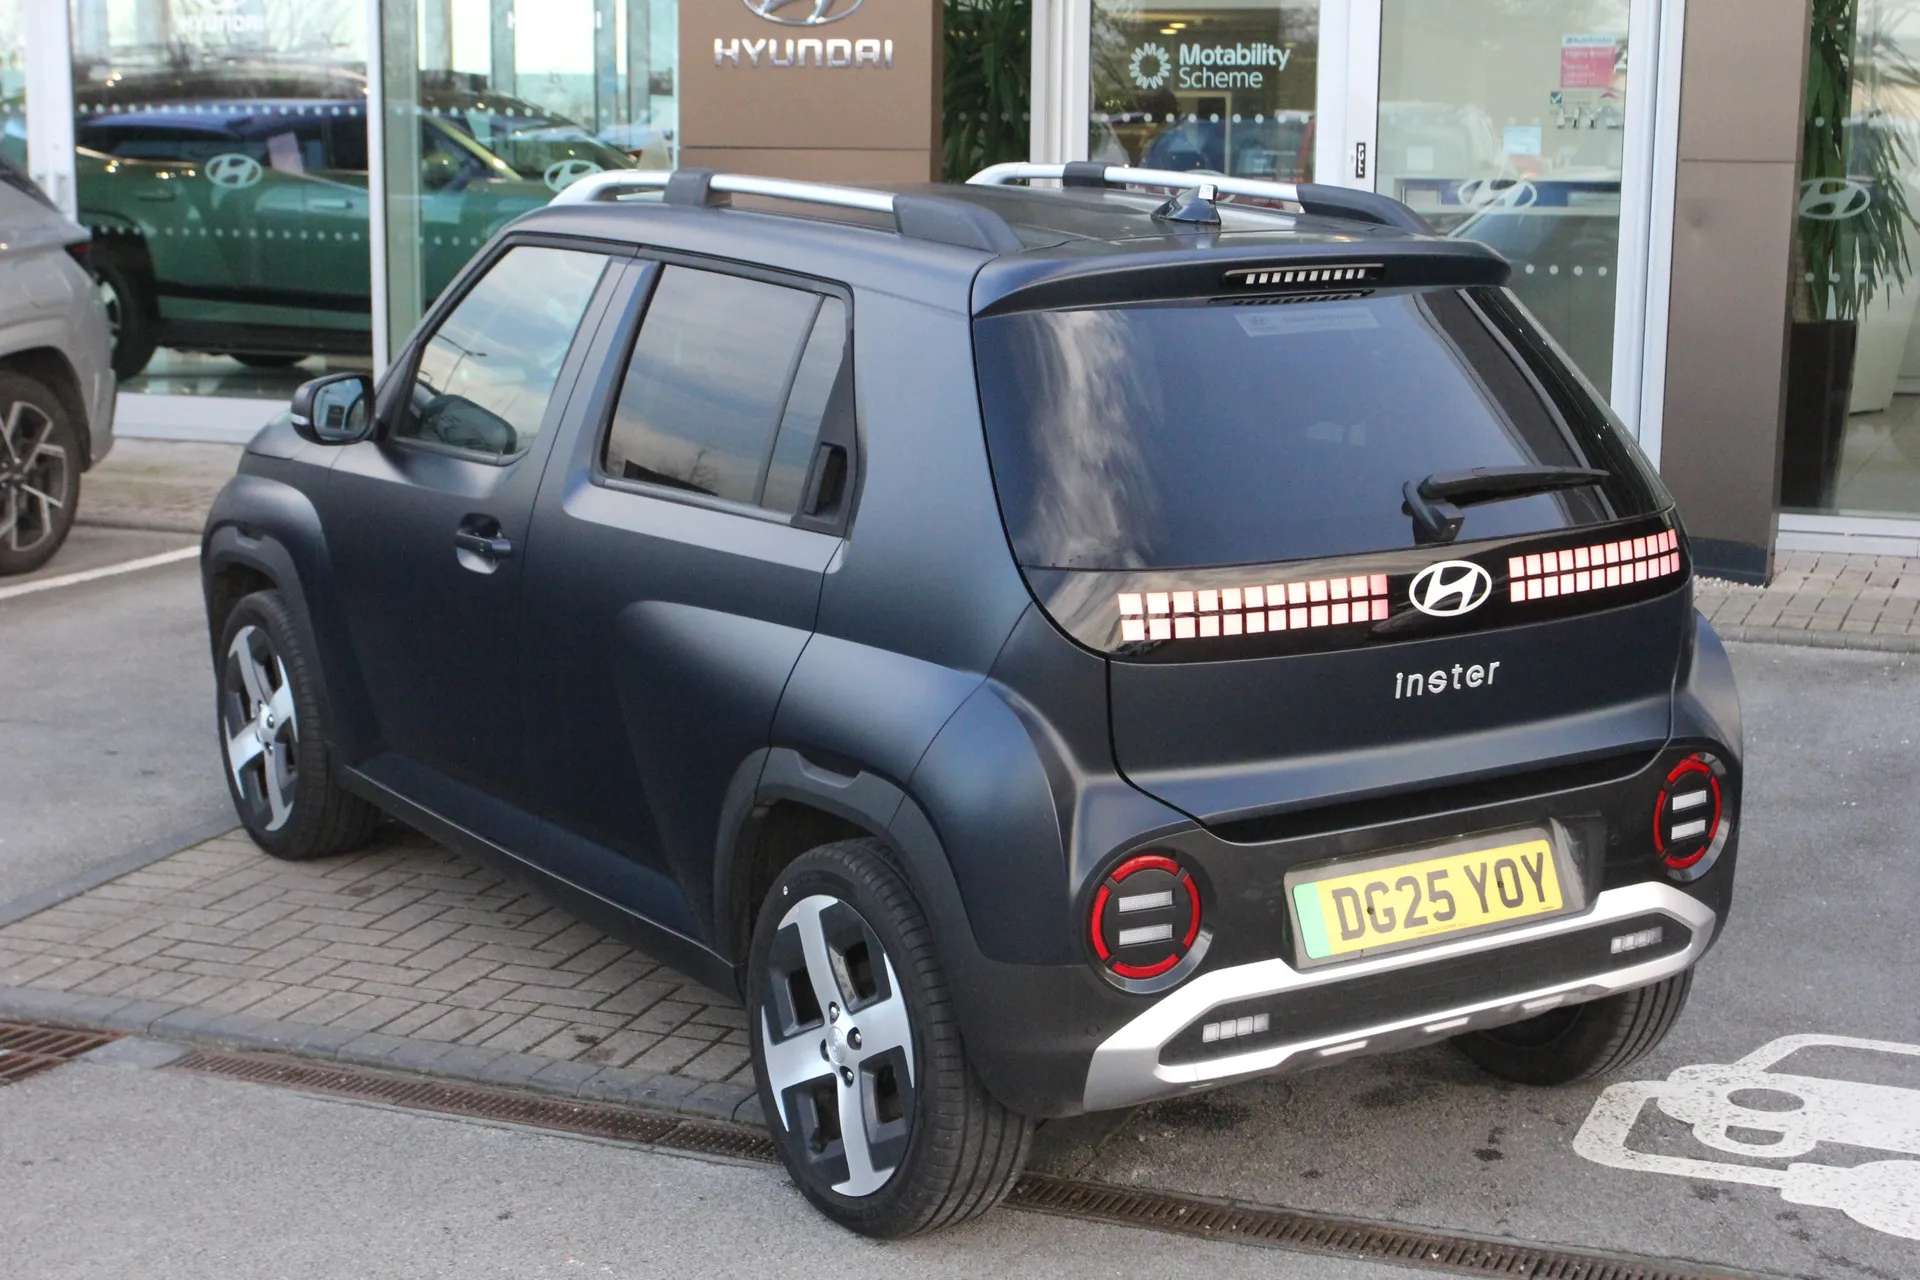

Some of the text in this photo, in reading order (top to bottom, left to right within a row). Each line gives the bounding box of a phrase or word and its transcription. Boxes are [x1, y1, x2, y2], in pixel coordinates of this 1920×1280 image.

[713, 38, 894, 67] HYUNDAI
[1178, 42, 1291, 71] Motability
[1178, 67, 1263, 88] Scheme
[1394, 661, 1501, 699] inster
[1331, 852, 1546, 941] DG25 YOY
